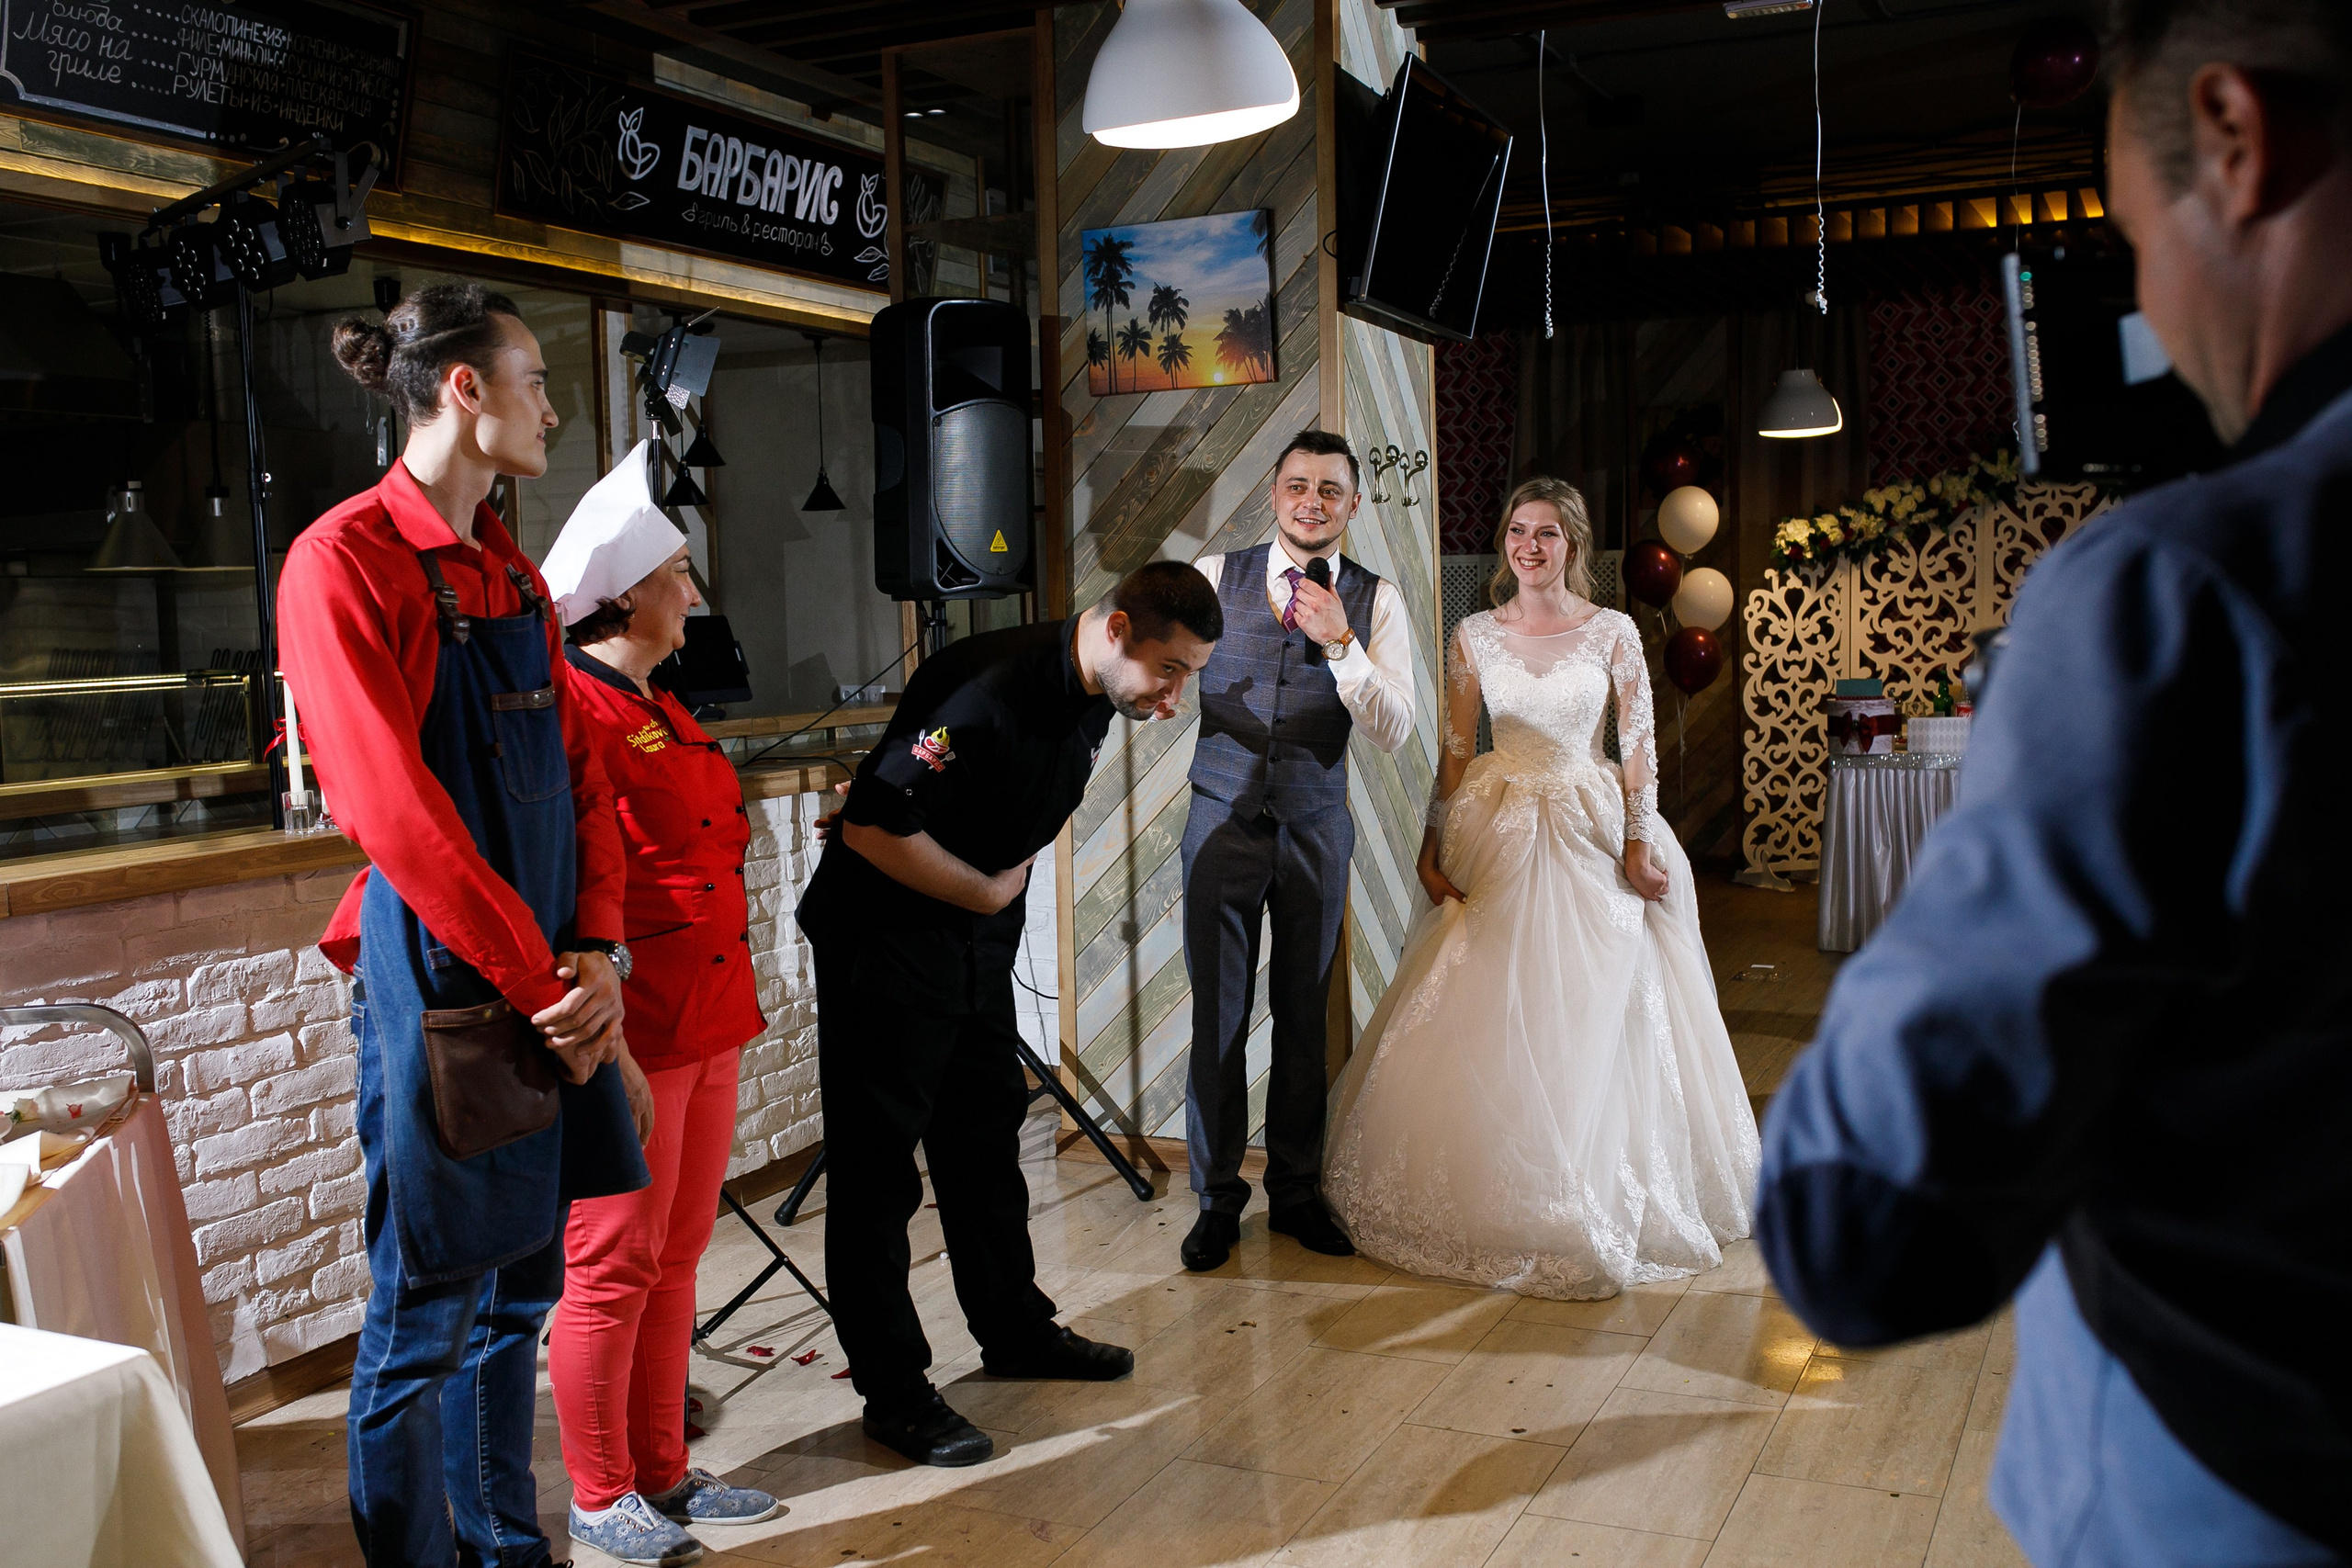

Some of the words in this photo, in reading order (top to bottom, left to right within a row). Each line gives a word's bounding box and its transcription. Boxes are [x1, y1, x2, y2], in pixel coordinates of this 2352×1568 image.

[13, 11, 91, 51] Мясо
[98, 35, 134, 61] на
[177, 28, 218, 55] ФИЛЕ
[181, 4, 265, 44] СКАЛОПИНЕ
[47, 50, 122, 87] гриле
[175, 51, 279, 94] ГУРМАНСКАЯ
[285, 75, 372, 118] ПЛЕСКАВИЦА
[173, 75, 244, 108] РУЛЕТЫ
[677, 124, 843, 226] БАРБАРИС
[697, 209, 738, 231] гриль
[752, 221, 820, 255] ресторан
